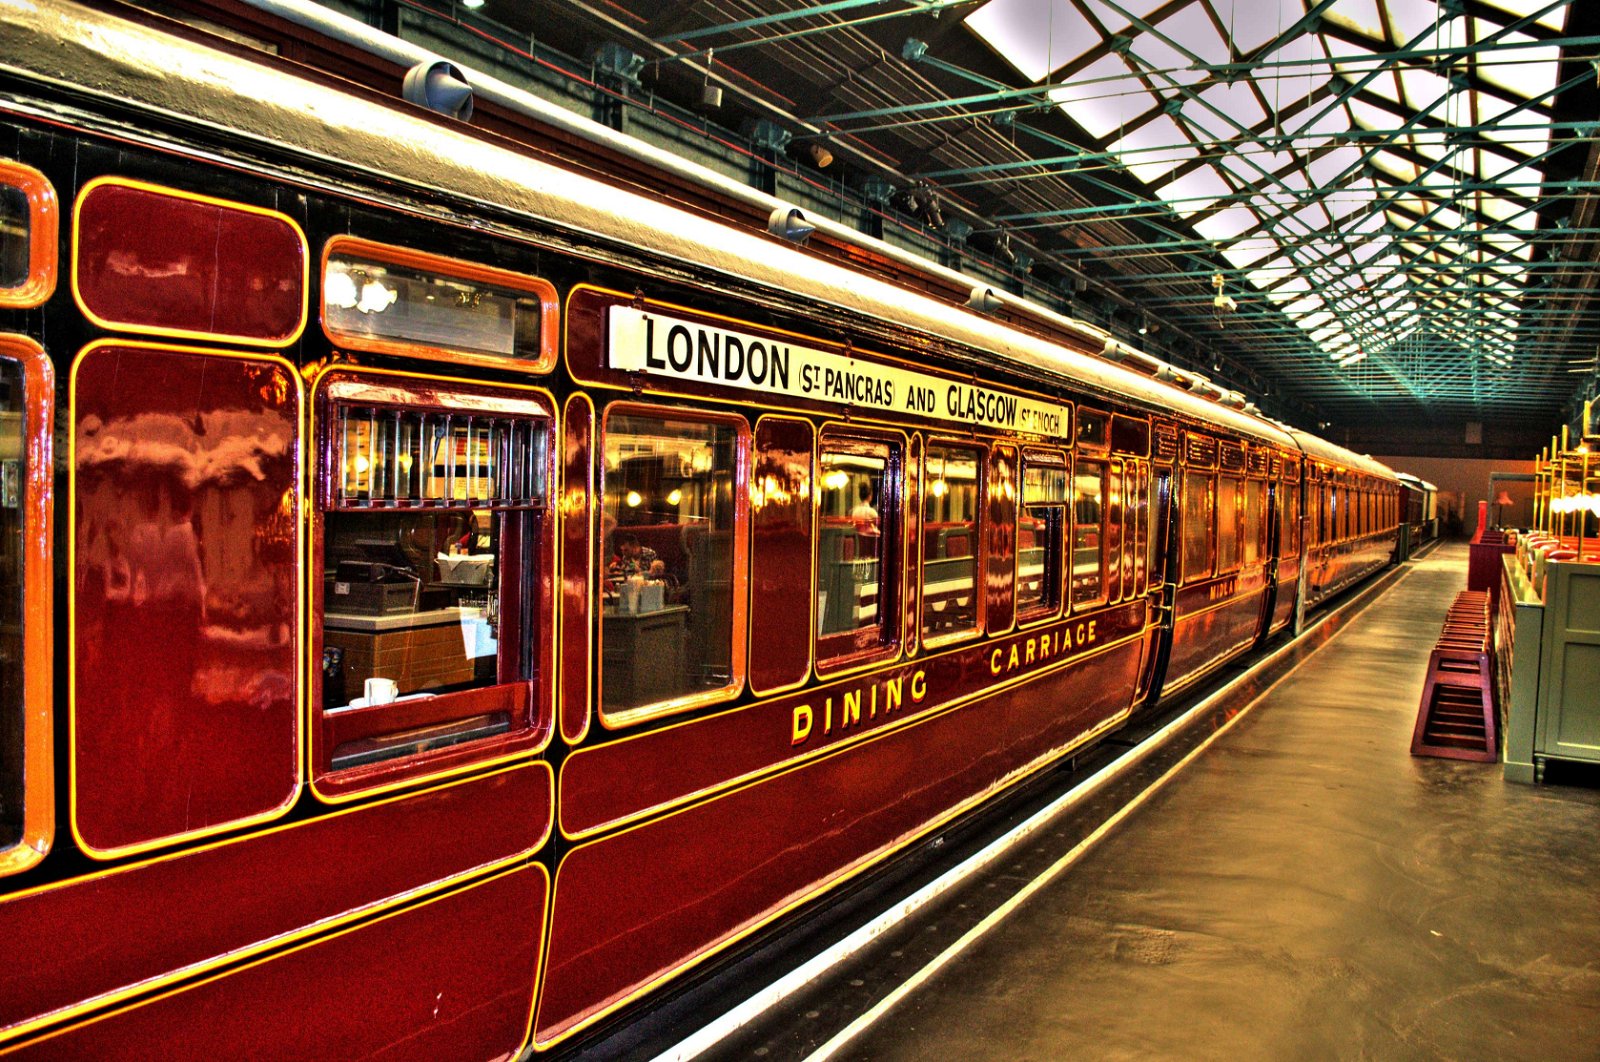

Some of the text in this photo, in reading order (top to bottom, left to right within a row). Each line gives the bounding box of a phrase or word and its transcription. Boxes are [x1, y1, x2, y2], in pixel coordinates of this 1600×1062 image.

[646, 318, 790, 390] LONDON
[906, 385, 936, 413] AND
[946, 384, 1018, 427] GLASGOW
[790, 619, 1097, 746] DINING CARRIAGE
